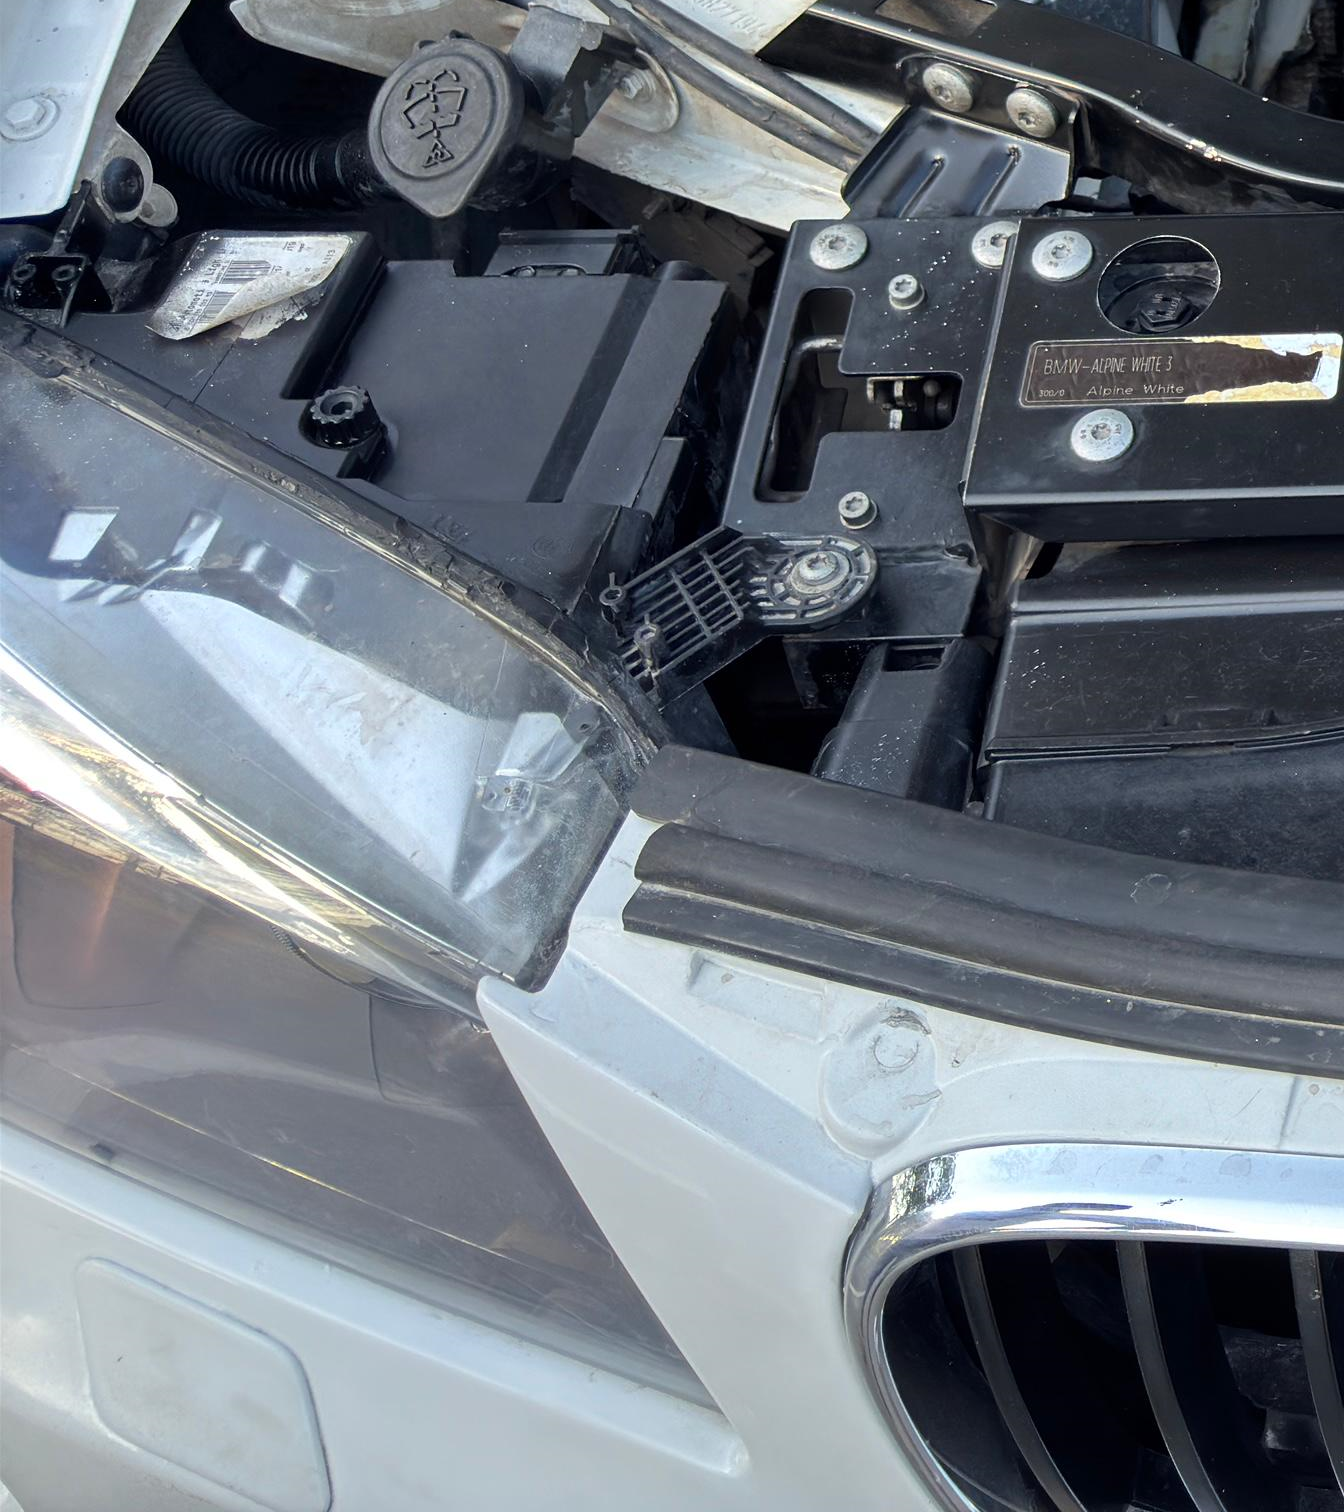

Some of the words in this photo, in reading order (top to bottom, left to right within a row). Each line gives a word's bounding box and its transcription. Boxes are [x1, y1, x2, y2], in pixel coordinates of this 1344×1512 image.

[1043, 357, 1126, 376] BMW-ALPINE
[1131, 355, 1162, 374] WHITE
[1164, 355, 1173, 372] 3
[1039, 389, 1065, 398] 300/0
[1086, 384, 1134, 398] Alpine
[1143, 383, 1185, 395] White
